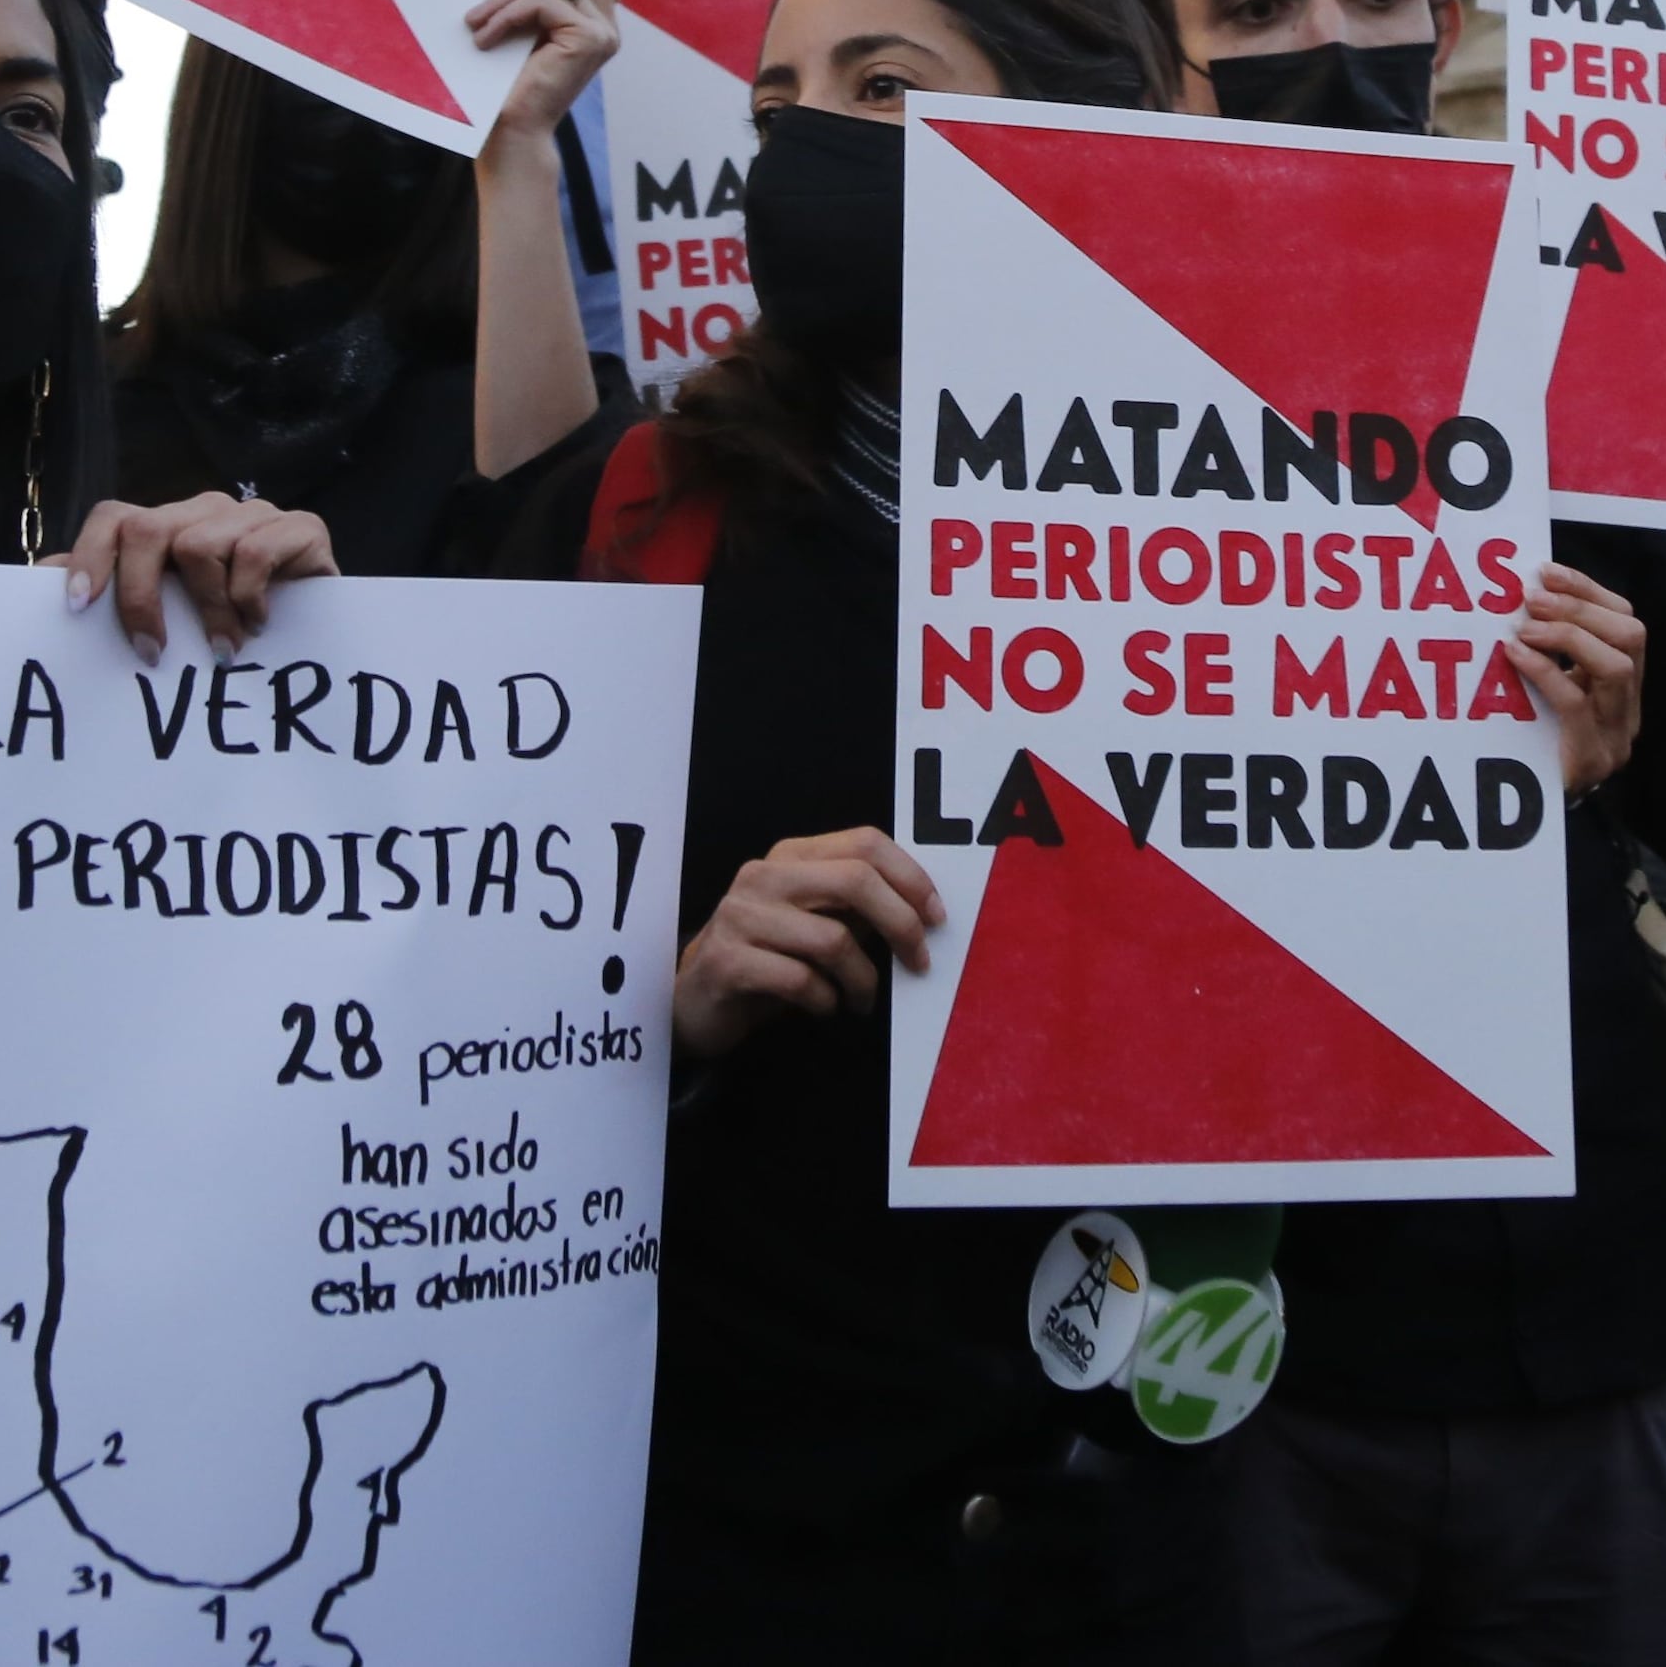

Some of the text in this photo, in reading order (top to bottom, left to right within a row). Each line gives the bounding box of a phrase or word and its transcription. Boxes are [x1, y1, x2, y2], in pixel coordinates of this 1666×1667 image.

[1525, 110, 1638, 180] NO
[637, 302, 745, 361] NO
[932, 387, 1513, 511] MATANDO
[930, 517, 1523, 615] PERIODISTAS
[134, 659, 572, 766] VERDAD
[920, 623, 1536, 722] NO SE MATA
[912, 747, 1544, 851] LA VERDAD
[13, 817, 647, 995] PERIODISTAS!
[276, 1000, 644, 1105] 28 periodistas
[340, 1110, 538, 1186] han sido
[318, 1181, 625, 1254] asesinados en
[311, 1222, 662, 1316] esta administración
[1045, 1304, 1096, 1361] RADIO
[102, 1430, 127, 1467] 2
[248, 1625, 275, 1667] 2
